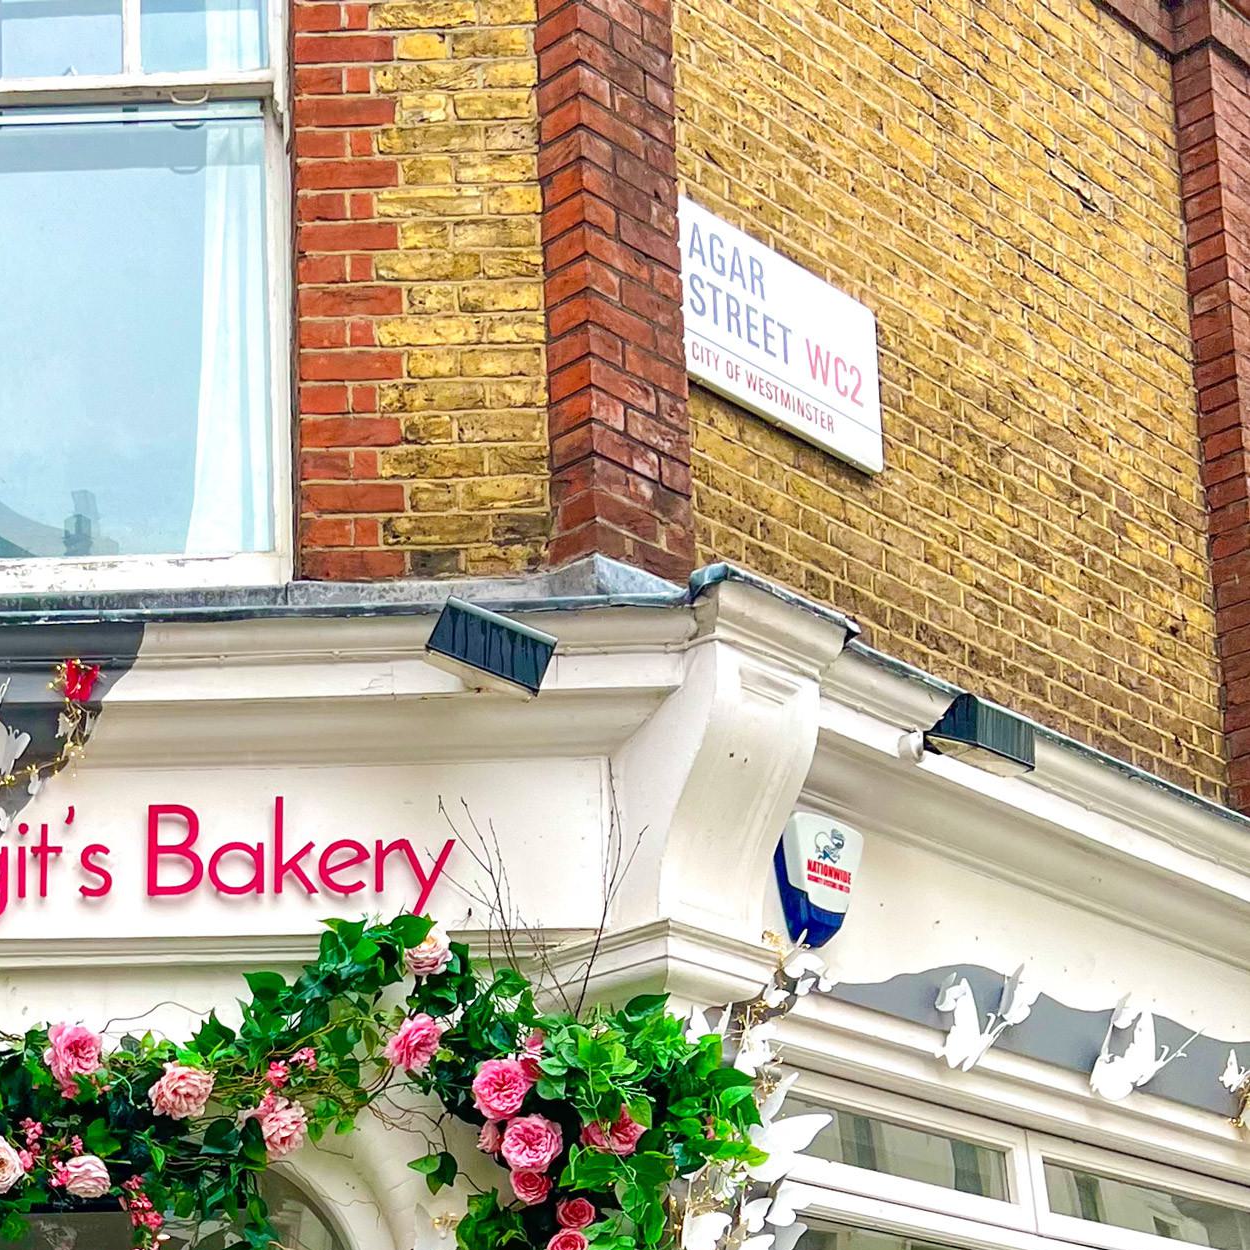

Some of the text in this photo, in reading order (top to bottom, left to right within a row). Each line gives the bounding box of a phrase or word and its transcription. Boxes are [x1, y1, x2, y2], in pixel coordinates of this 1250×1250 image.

[688, 222, 765, 301] AGAR
[689, 273, 865, 408] STREET WC2
[691, 341, 836, 434] CITY OF WESTMINSTER
[148, 796, 456, 916] Bakery
[807, 859, 851, 885] NATIONWIDE
